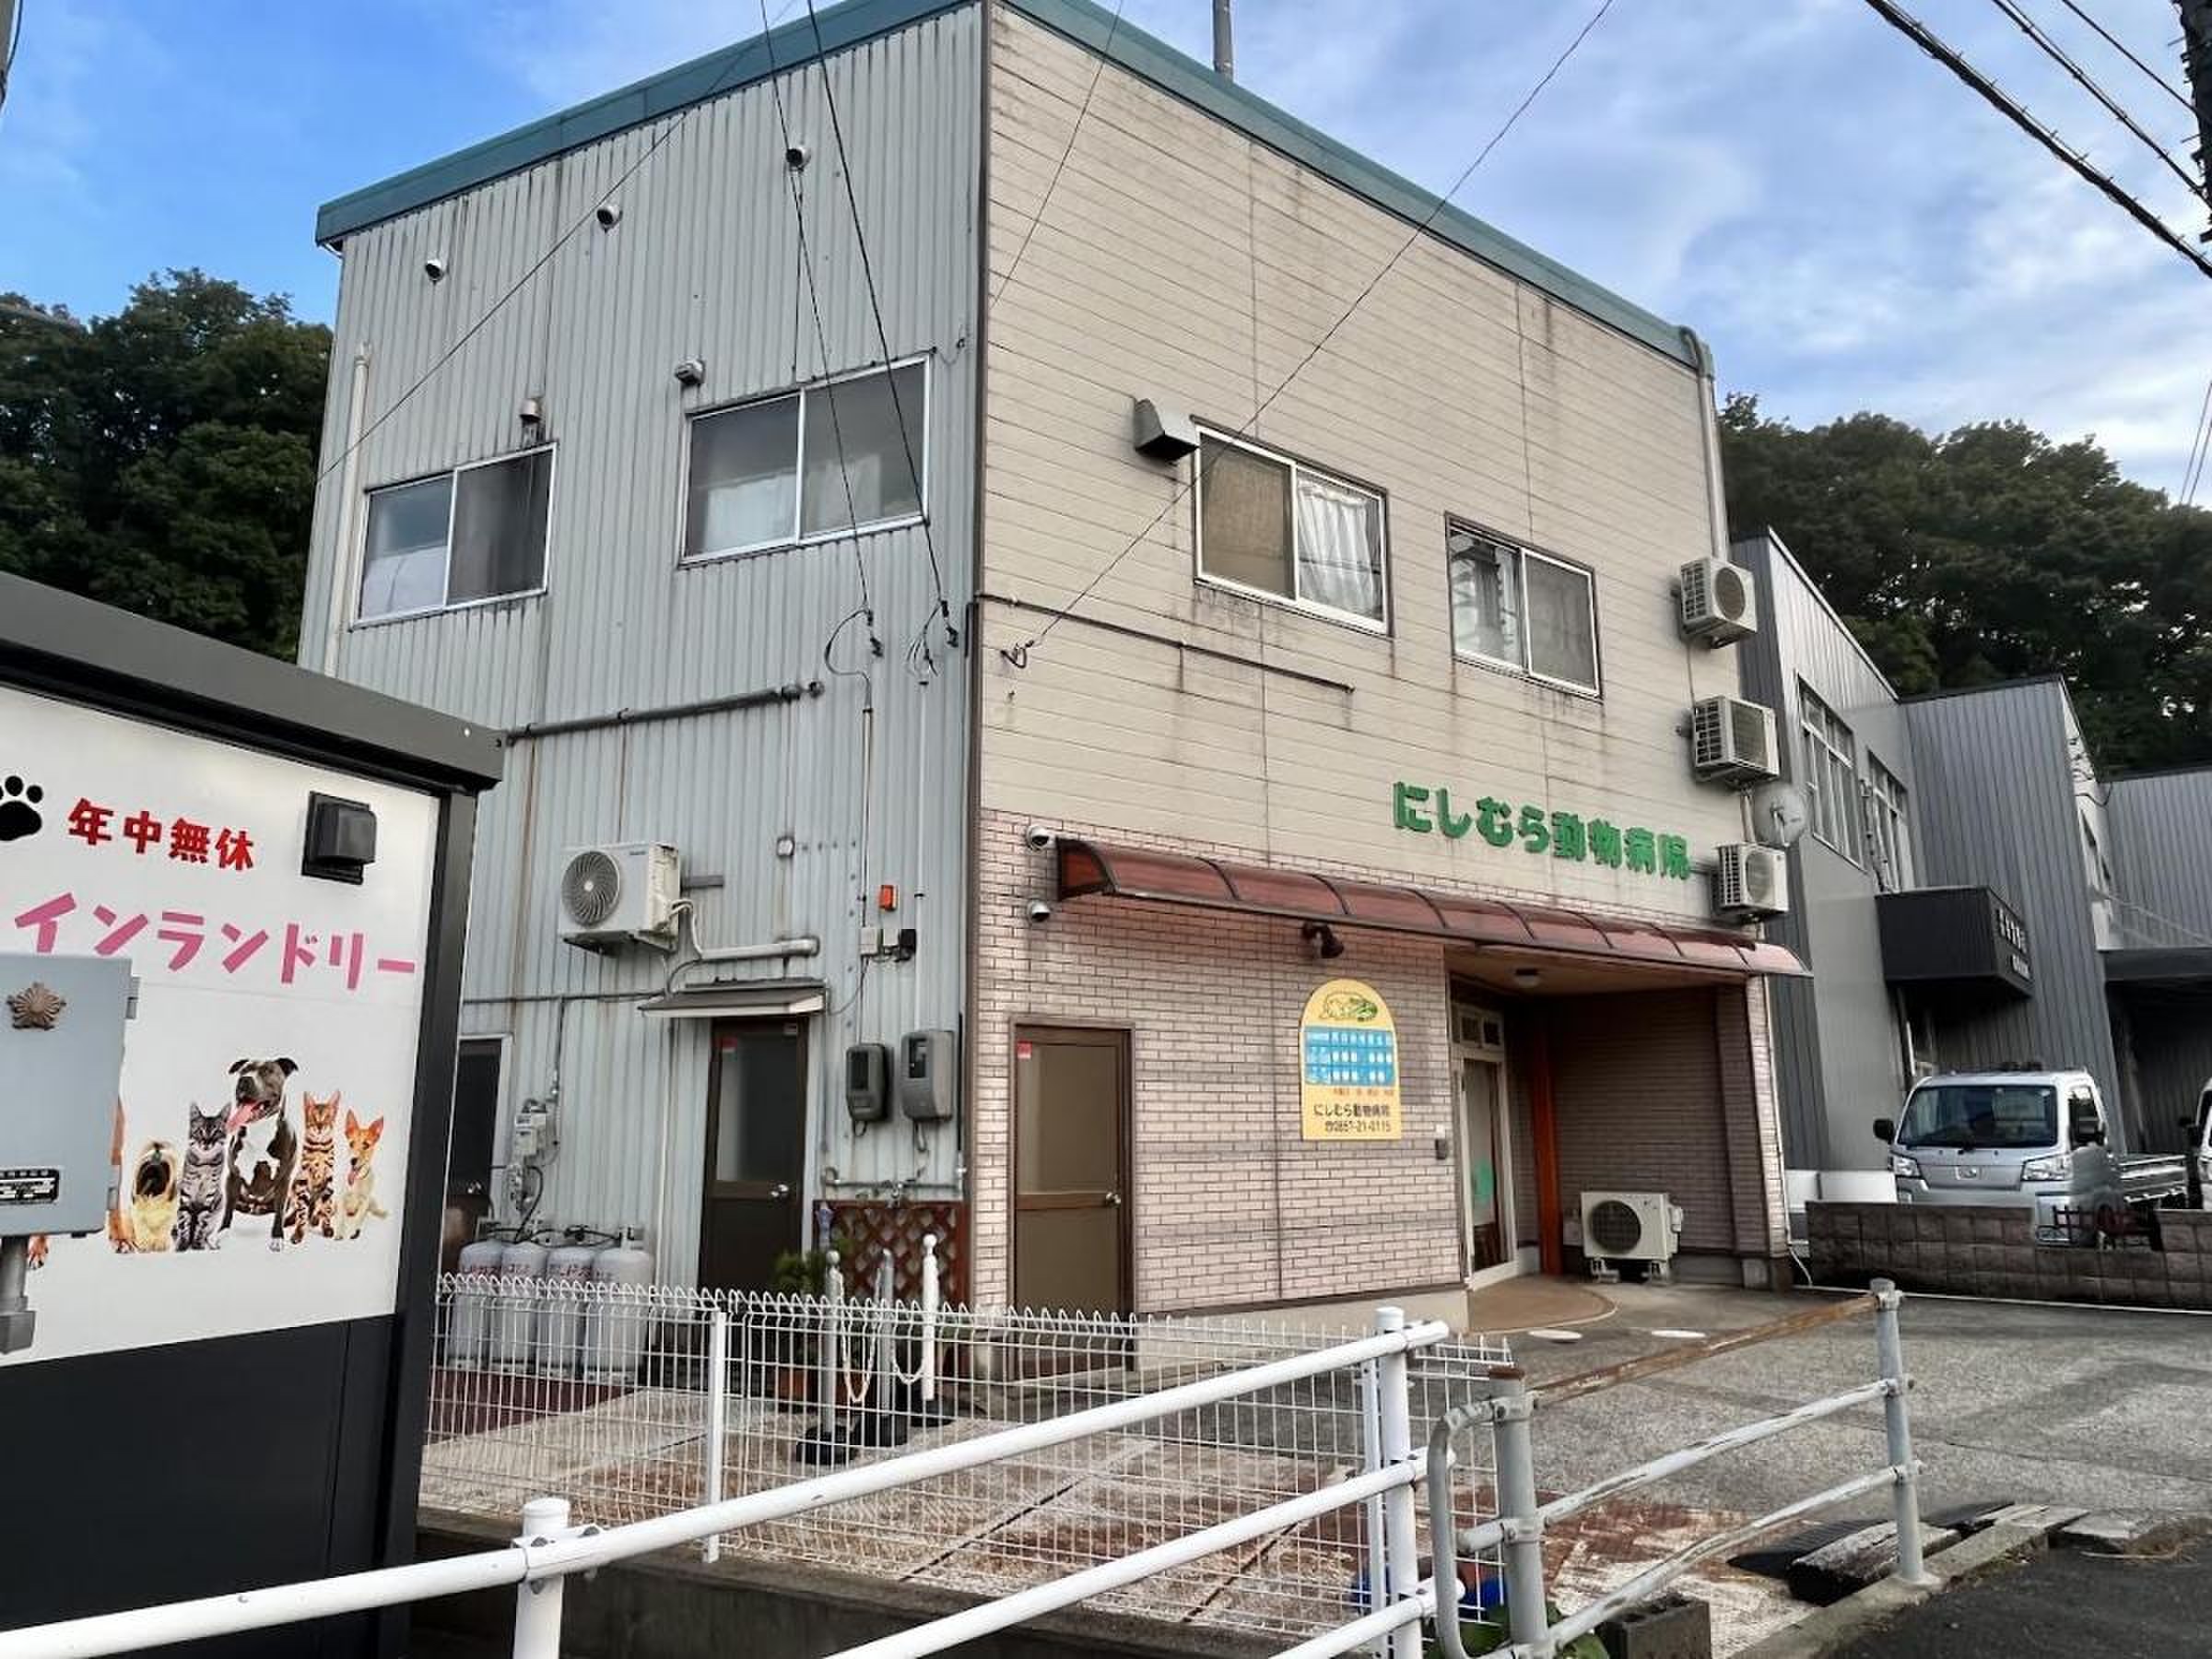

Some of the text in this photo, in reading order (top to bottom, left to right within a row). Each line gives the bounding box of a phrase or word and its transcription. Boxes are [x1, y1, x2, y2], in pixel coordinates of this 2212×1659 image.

[69, 799, 254, 871] 年中無休
[1394, 782, 1691, 880] にしむら動物病院
[15, 892, 416, 990] インランドリー
